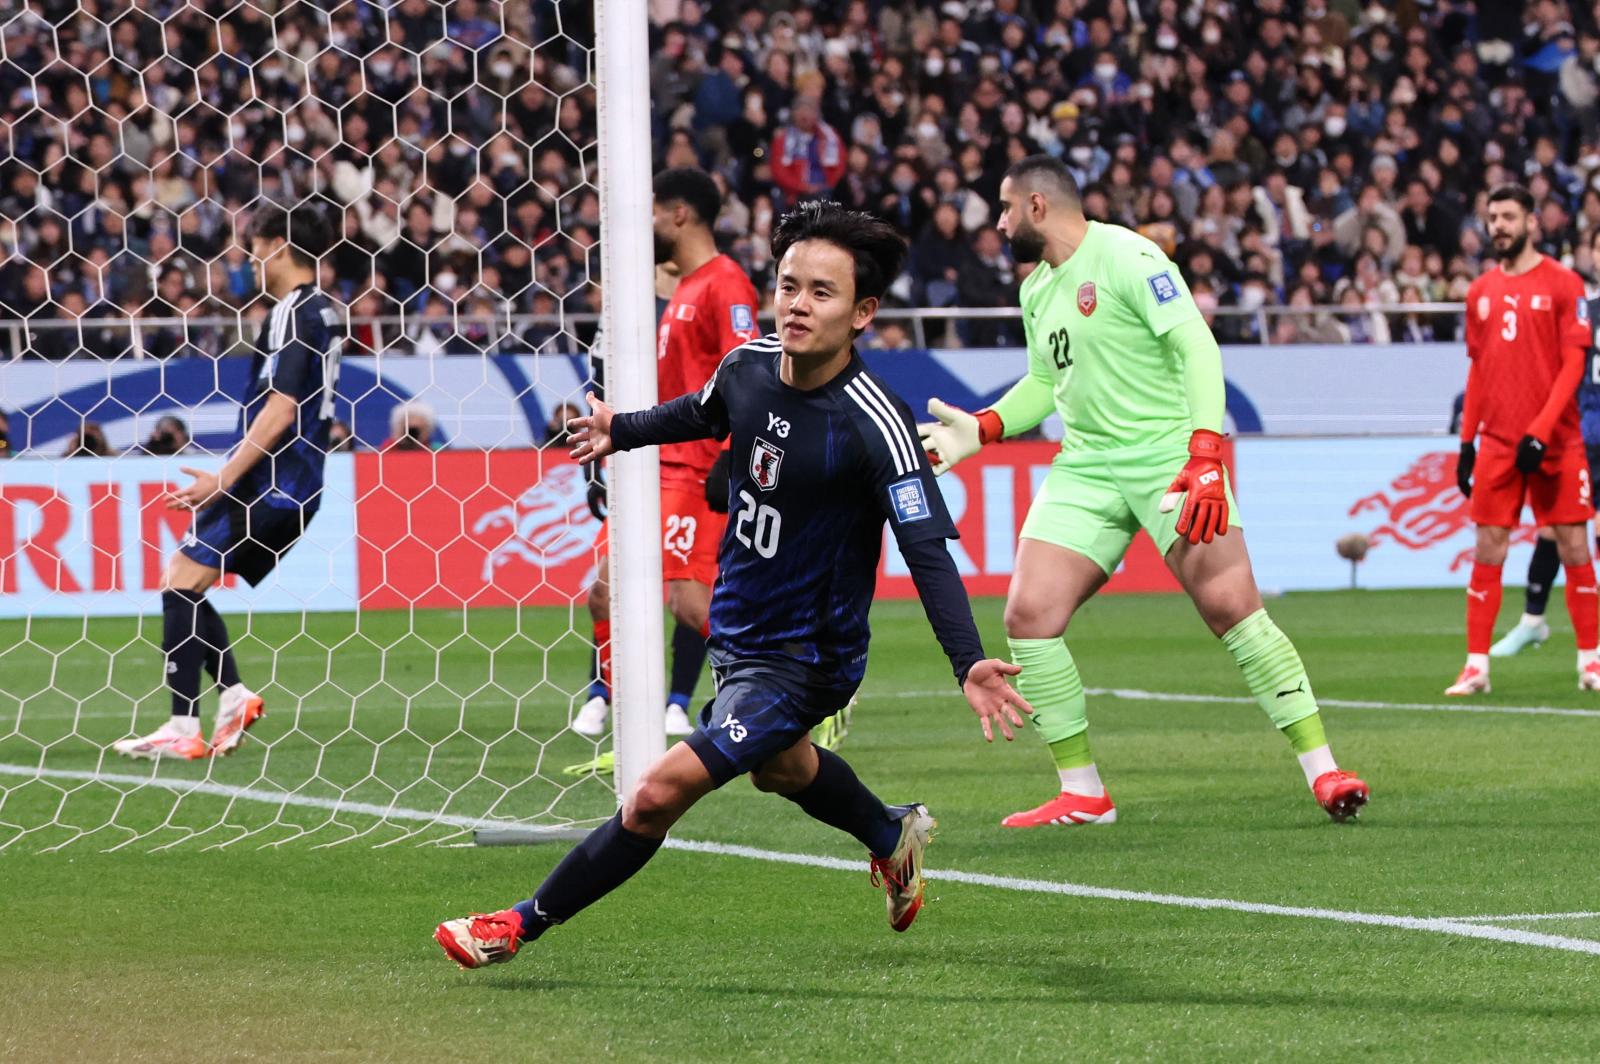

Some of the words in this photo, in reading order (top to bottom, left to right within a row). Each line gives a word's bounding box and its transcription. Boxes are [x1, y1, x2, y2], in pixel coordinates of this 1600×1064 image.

[1501, 310, 1518, 342] 3
[1048, 327, 1073, 370] 22
[761, 442, 777, 453] JAPAN
[896, 485, 917, 494] FOOTBALL
[898, 490, 920, 502] UNITES
[1579, 468, 1590, 498] 3
[664, 515, 697, 550] 23
[735, 489, 782, 559] 20
